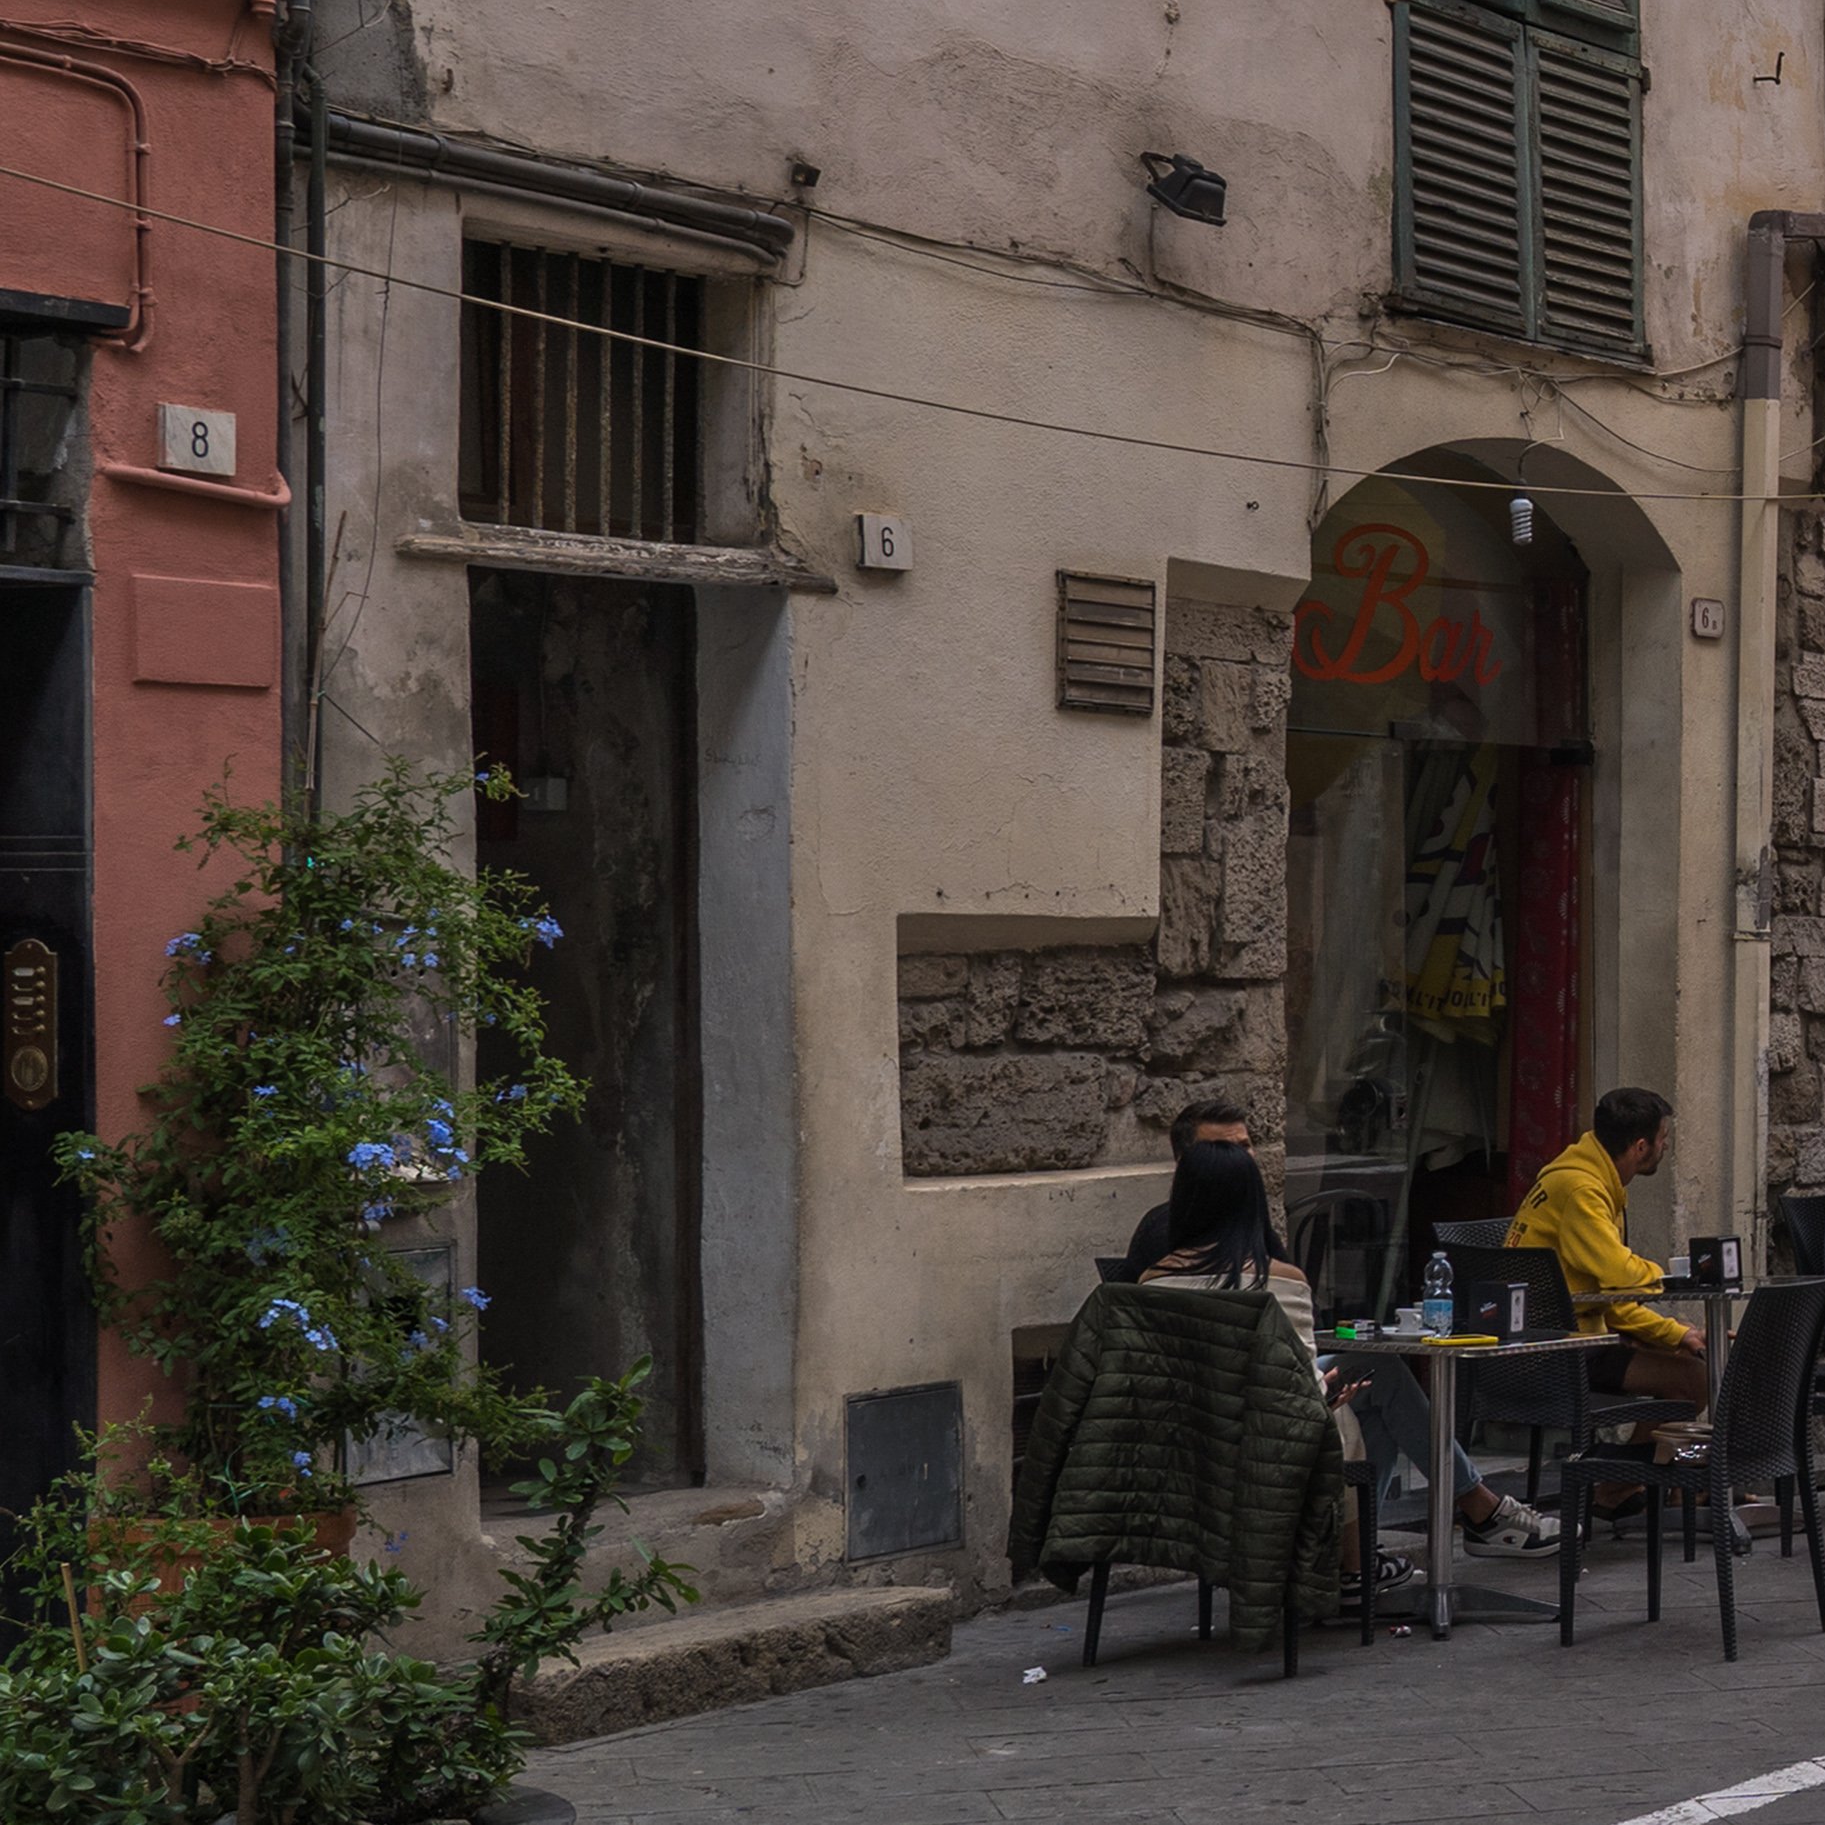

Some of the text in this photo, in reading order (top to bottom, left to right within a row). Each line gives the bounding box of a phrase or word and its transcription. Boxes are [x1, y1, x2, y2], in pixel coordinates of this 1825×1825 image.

[192, 421, 209, 458] 8
[881, 526, 895, 557] 6
[1292, 523, 1503, 687] Bar
